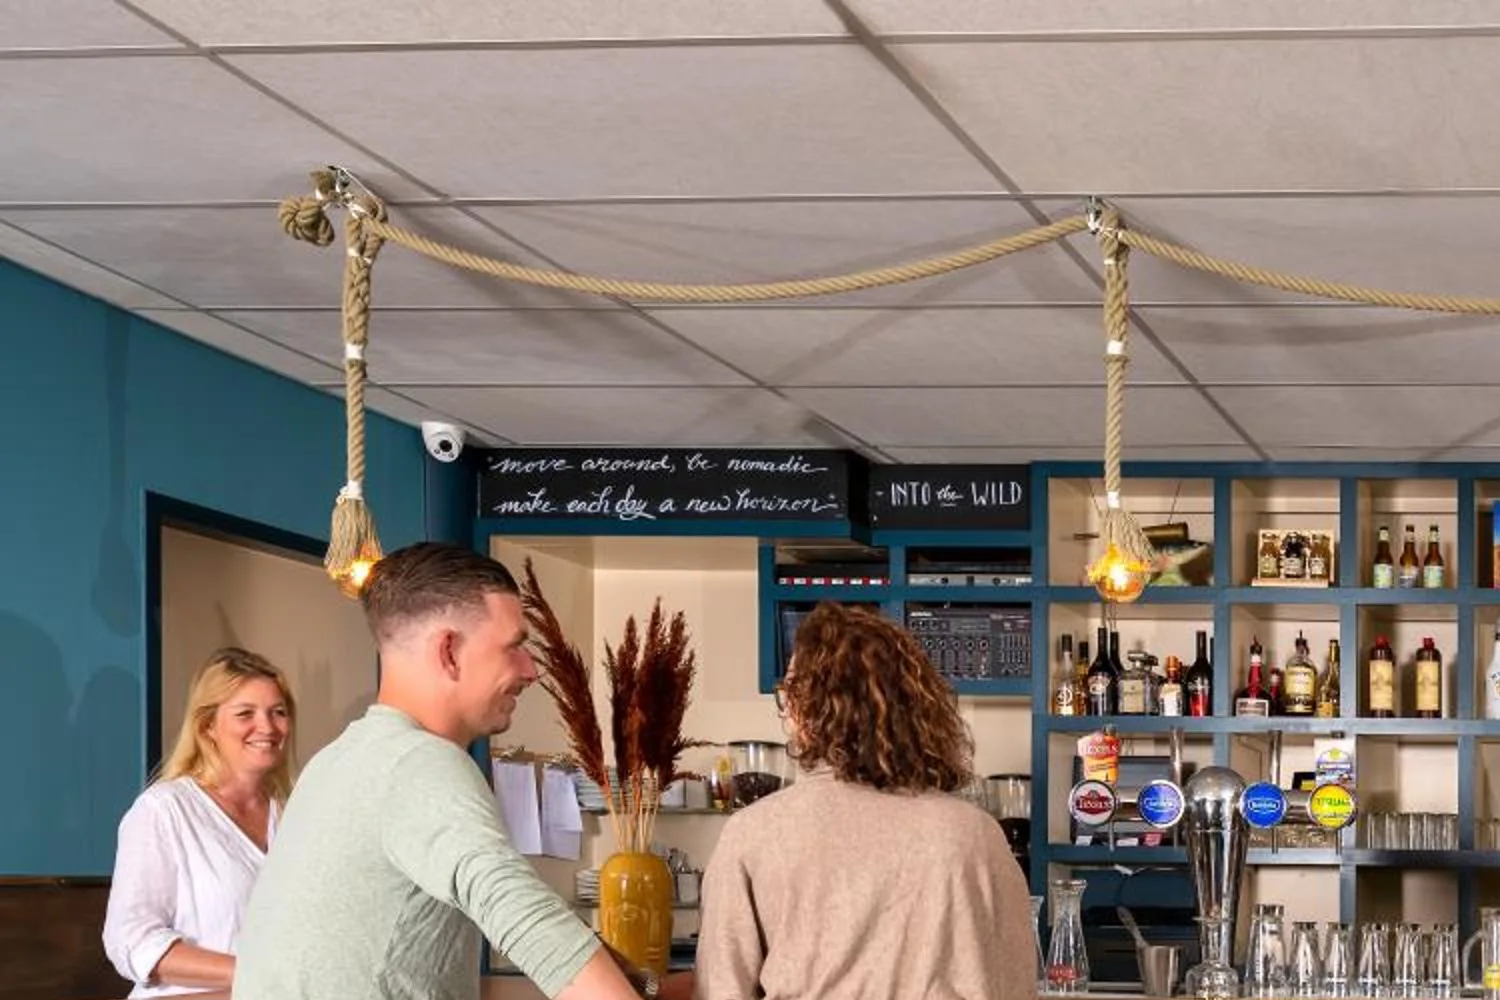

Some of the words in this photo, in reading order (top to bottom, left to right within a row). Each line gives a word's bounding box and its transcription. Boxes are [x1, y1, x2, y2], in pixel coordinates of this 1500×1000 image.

[490, 458, 574, 473] move
[686, 453, 718, 472] be
[728, 455, 828, 472] nomadic
[492, 488, 557, 513] make
[567, 485, 612, 513] each
[615, 484, 656, 521] day
[659, 497, 677, 513] a
[685, 496, 731, 513] new
[891, 481, 931, 507] INTO
[936, 484, 965, 507] the
[971, 481, 1023, 506] WILD
